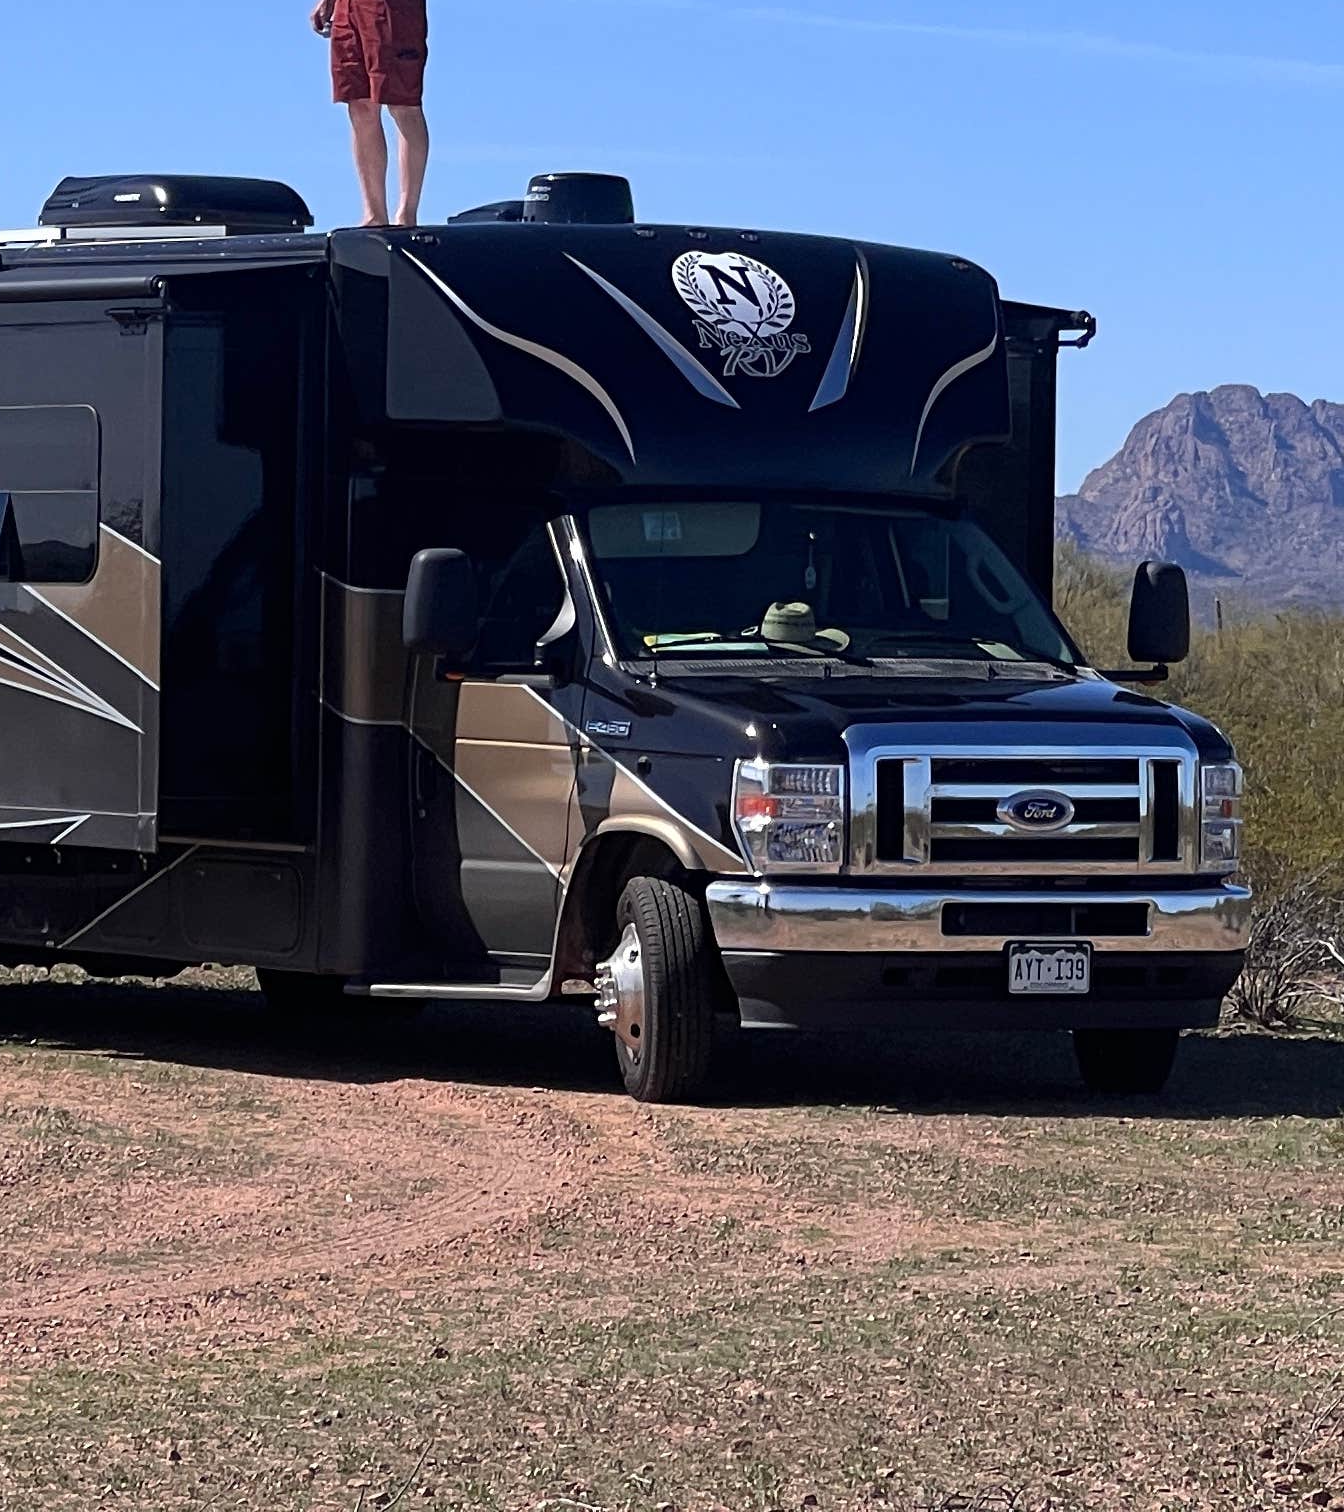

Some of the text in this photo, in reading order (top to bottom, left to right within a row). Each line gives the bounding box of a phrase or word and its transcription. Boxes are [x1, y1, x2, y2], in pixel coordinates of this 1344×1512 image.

[698, 264, 762, 308] N
[720, 344, 797, 377] RV
[1024, 801, 1057, 819] Ford
